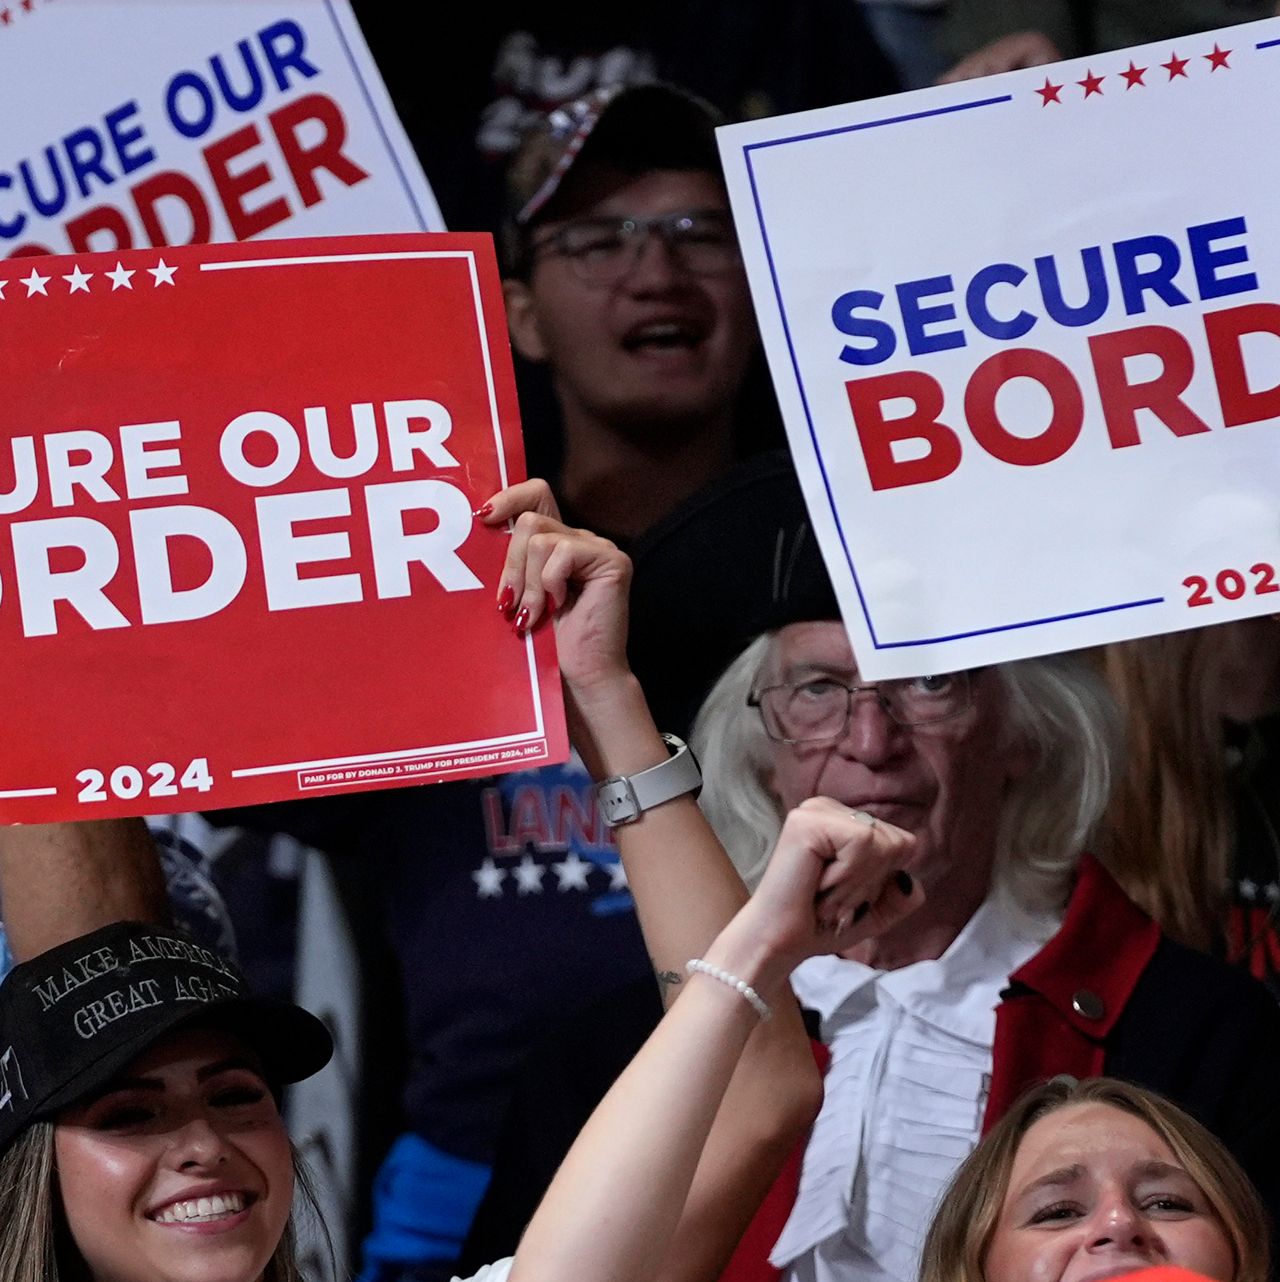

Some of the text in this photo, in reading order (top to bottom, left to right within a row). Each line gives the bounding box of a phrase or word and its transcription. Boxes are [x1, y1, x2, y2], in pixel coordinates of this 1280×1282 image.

[164, 18, 321, 138] OUR
[831, 216, 1258, 365] SECURE
[219, 399, 460, 488] OUR
[75, 757, 213, 803] 2024
[304, 775, 326, 785] PAID
[327, 772, 344, 782] FOR
[345, 770, 357, 779] BY
[358, 766, 393, 777] DONALD
[404, 762, 433, 772] TRUMP
[434, 759, 452, 768] FOR
[453, 752, 499, 766] PRESIDENT
[501, 749, 523, 759] 2024,
[524, 745, 541, 754] INC.
[31, 945, 120, 1012] MAKE
[73, 977, 164, 1039] GREAT
